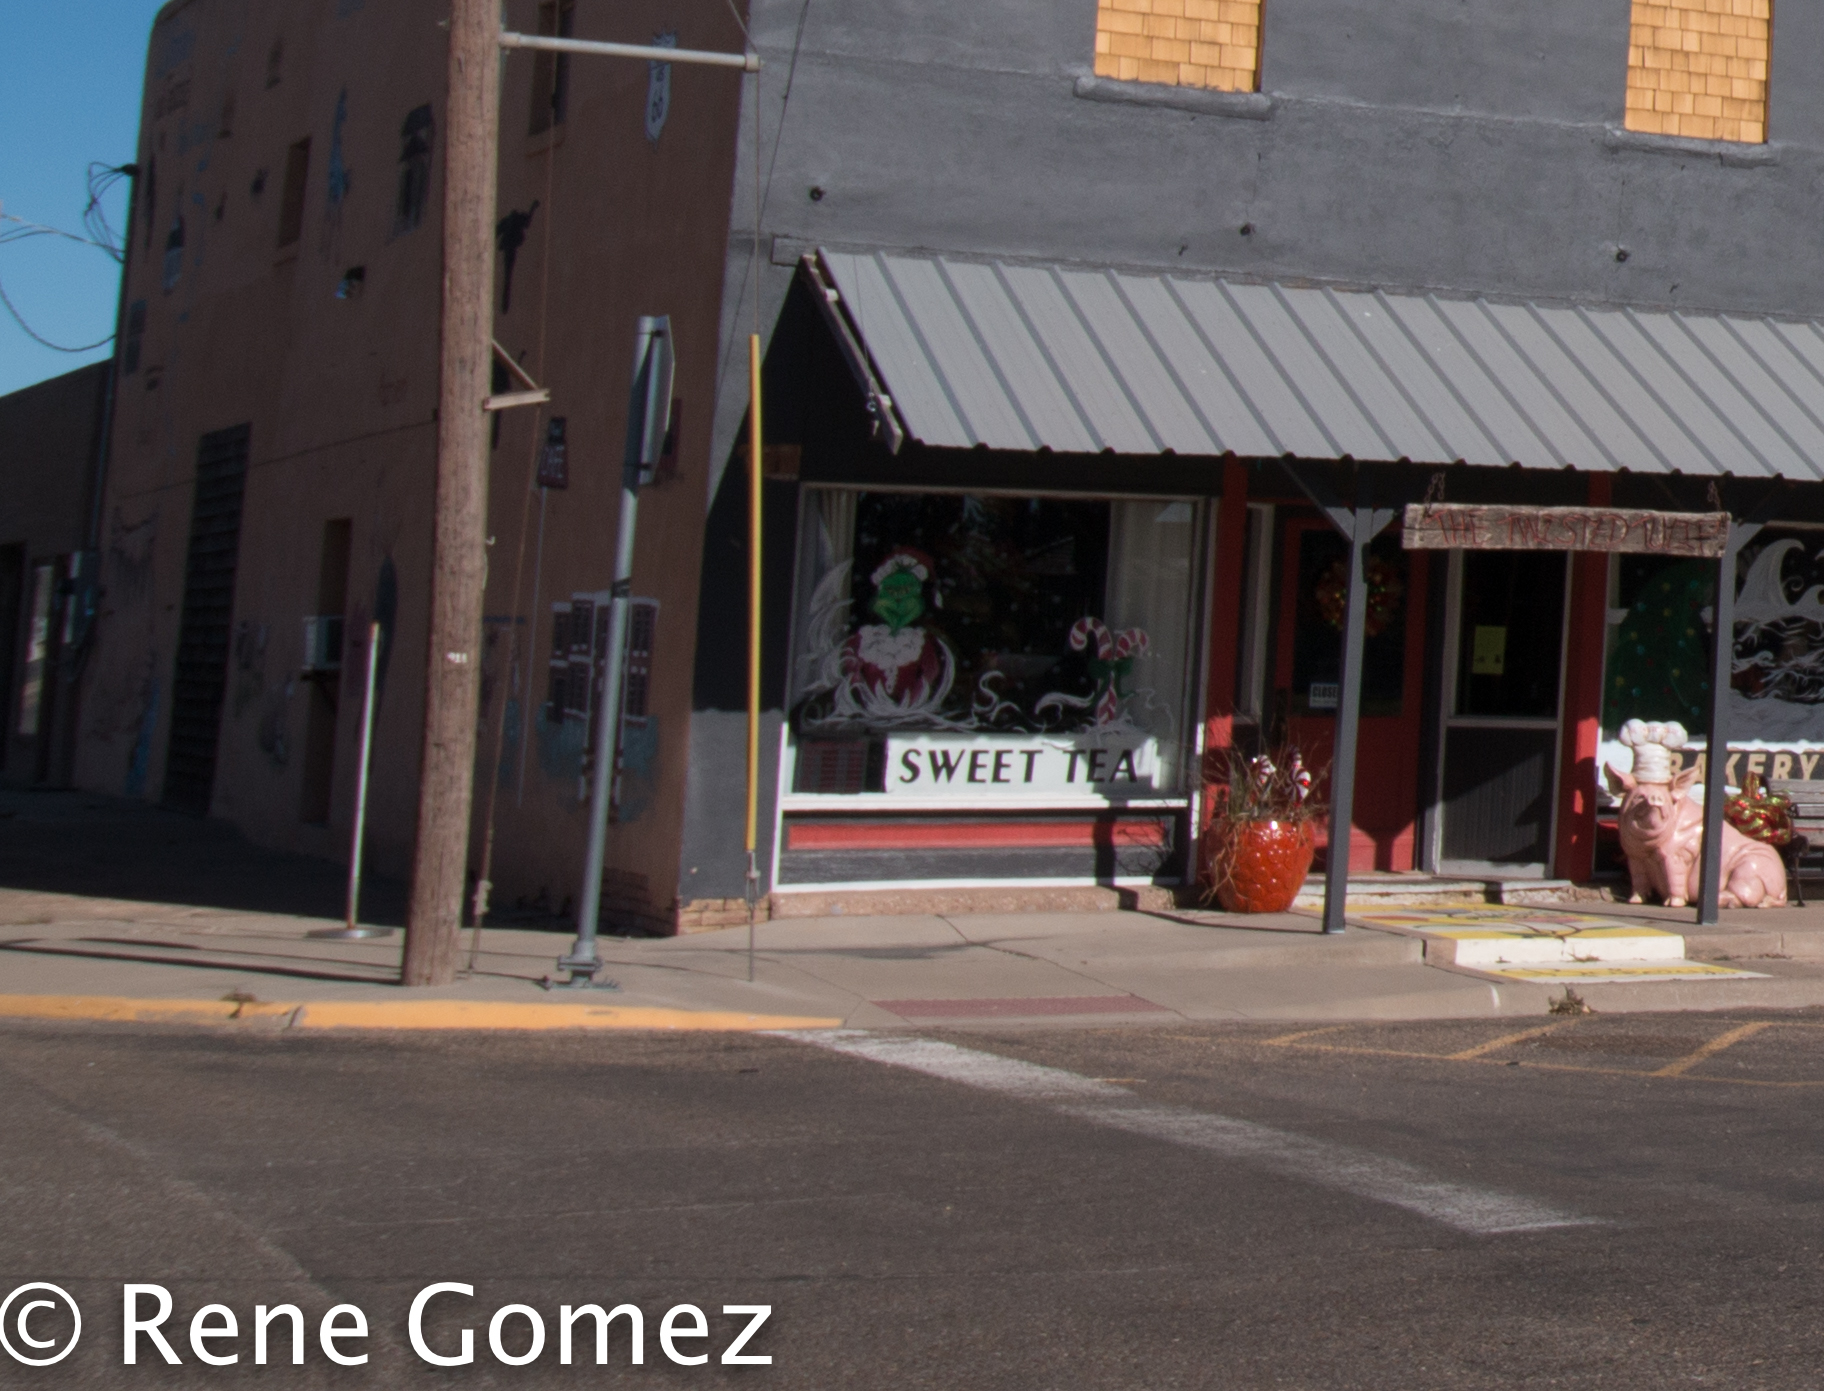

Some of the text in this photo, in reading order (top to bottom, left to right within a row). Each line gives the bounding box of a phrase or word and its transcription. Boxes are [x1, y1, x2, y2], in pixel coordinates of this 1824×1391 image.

[1422, 509, 1488, 546] THE
[1497, 512, 1630, 547] TWISTED
[1312, 685, 1338, 699] CLOSE
[899, 748, 1139, 784] SWEET TEA
